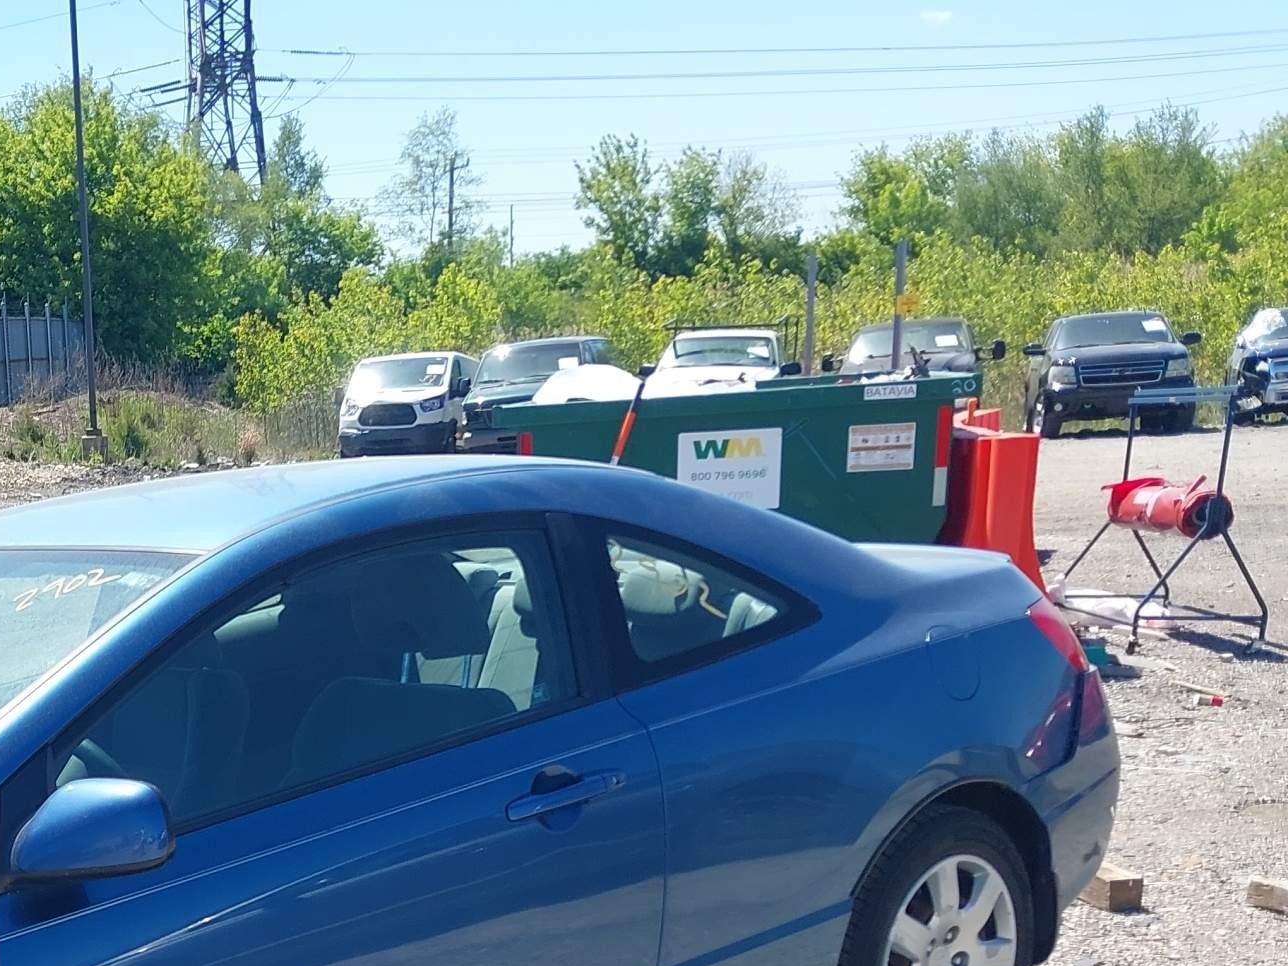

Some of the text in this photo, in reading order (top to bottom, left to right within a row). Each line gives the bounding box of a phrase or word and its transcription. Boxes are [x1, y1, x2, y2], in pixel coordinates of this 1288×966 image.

[866, 385, 915, 397] BATAVIA
[693, 438, 762, 460] WM
[691, 471, 712, 481] 800
[715, 471, 736, 480] 796
[12, 568, 121, 612] 2902
